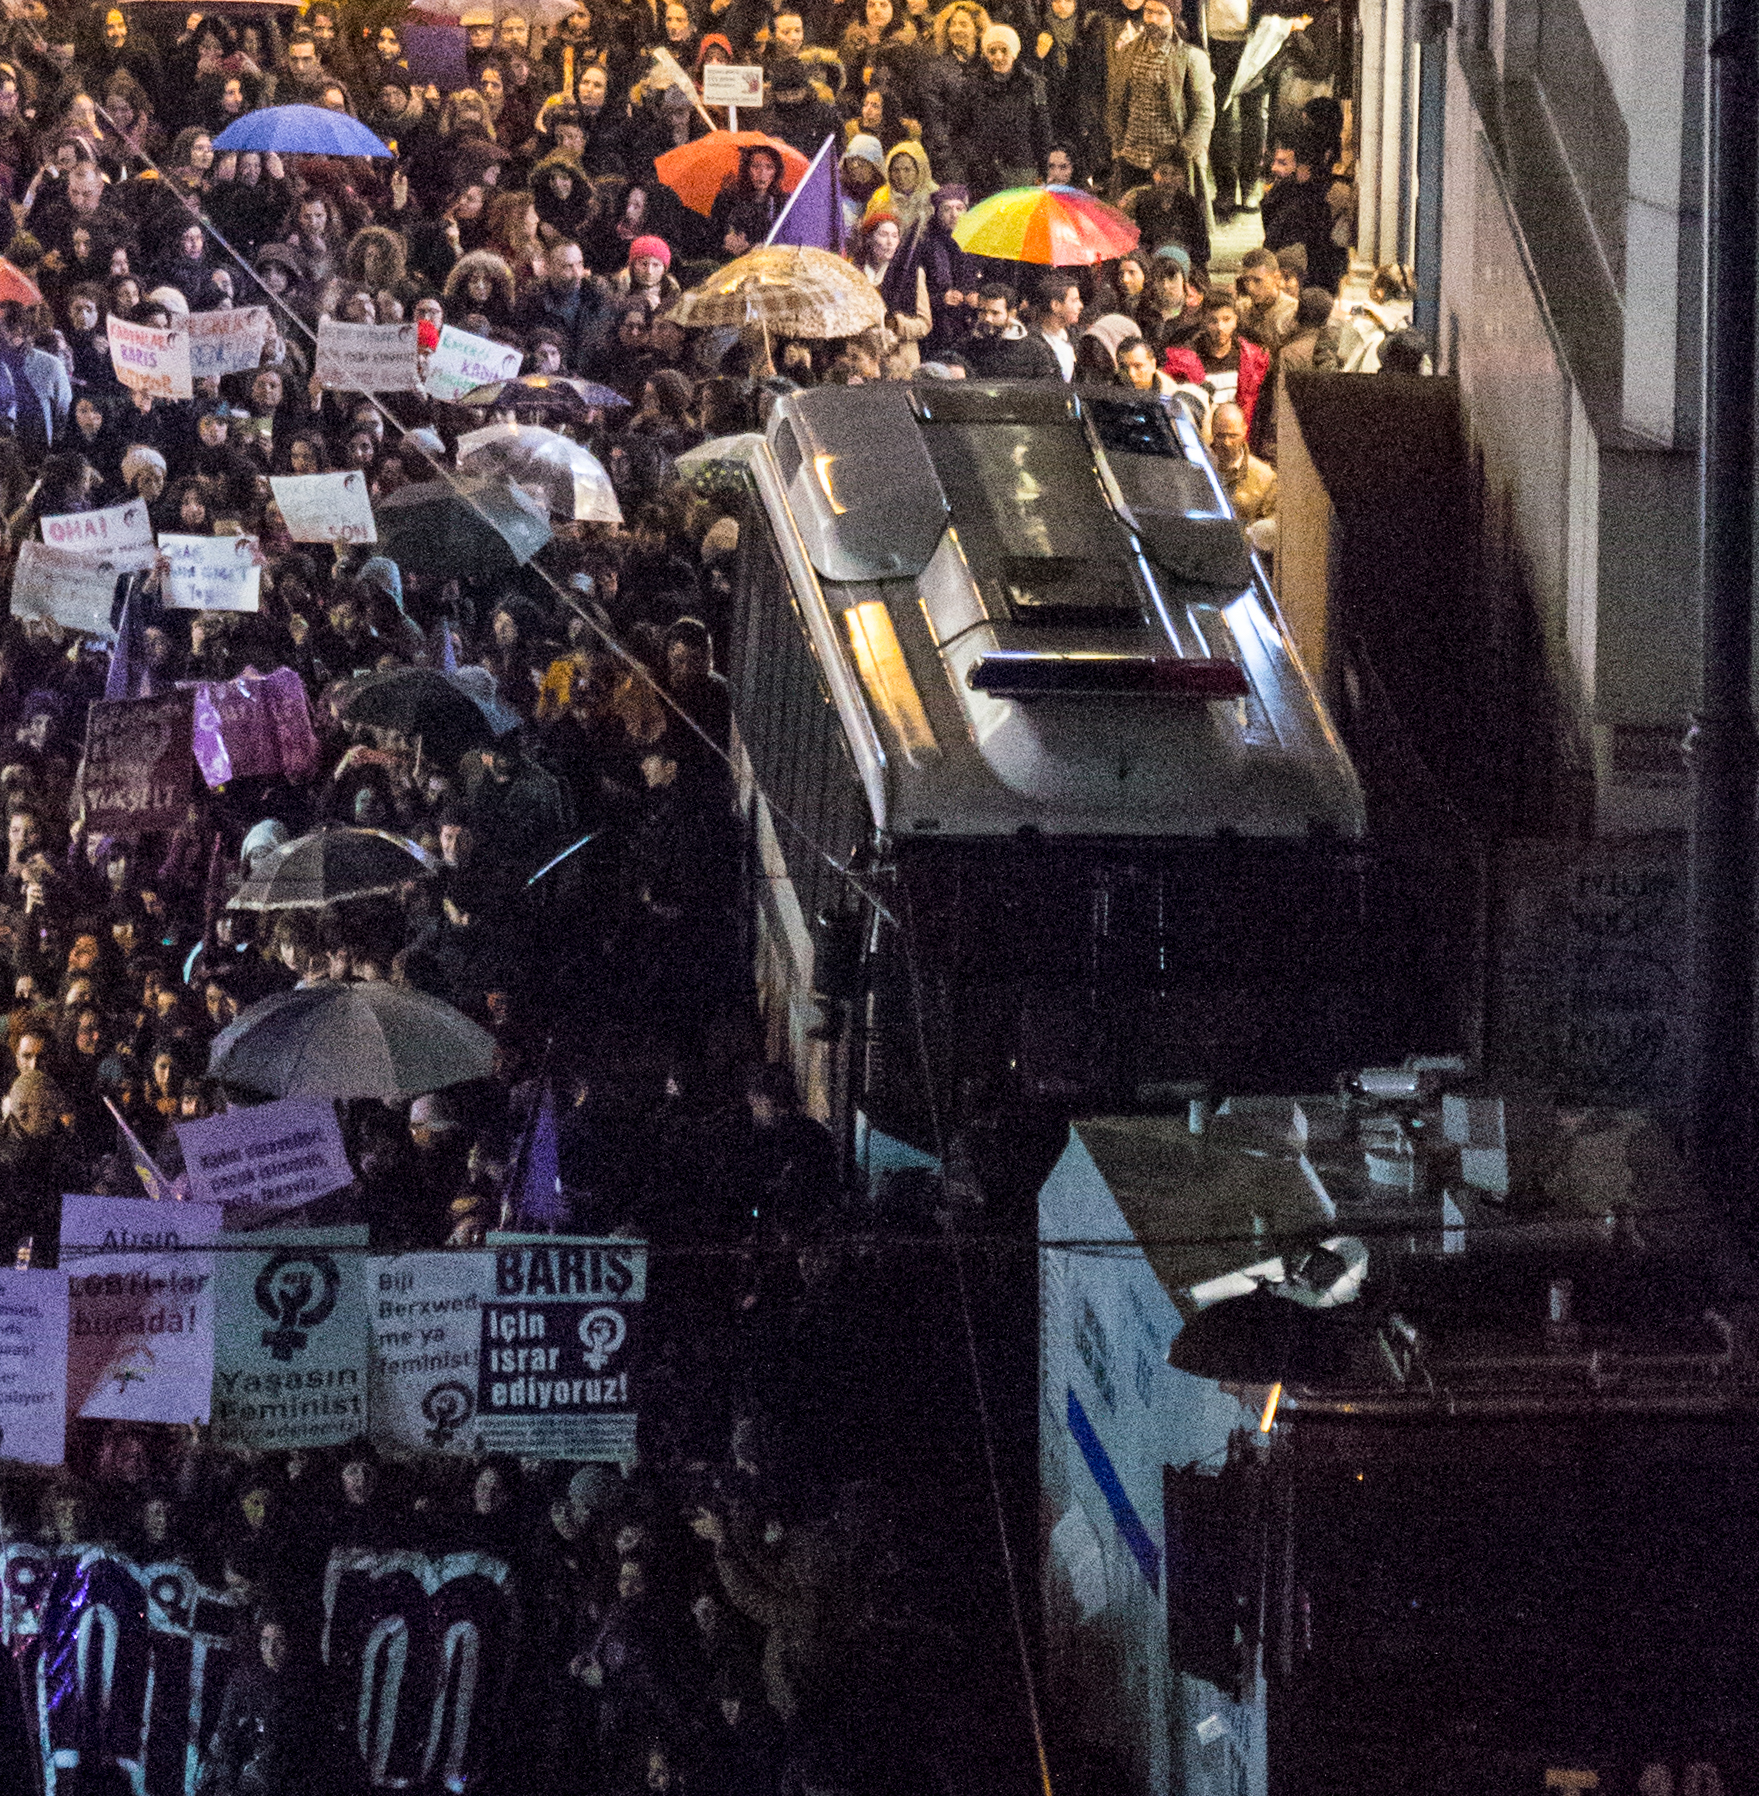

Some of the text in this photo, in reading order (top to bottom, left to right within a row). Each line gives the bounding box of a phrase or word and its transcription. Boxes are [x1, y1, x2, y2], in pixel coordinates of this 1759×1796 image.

[495, 1249, 634, 1301] BARIŞ
[378, 1292, 478, 1319] Berxwed
[219, 1365, 358, 1395] Yaşasın
[490, 1372, 629, 1409] ediyoruz!
